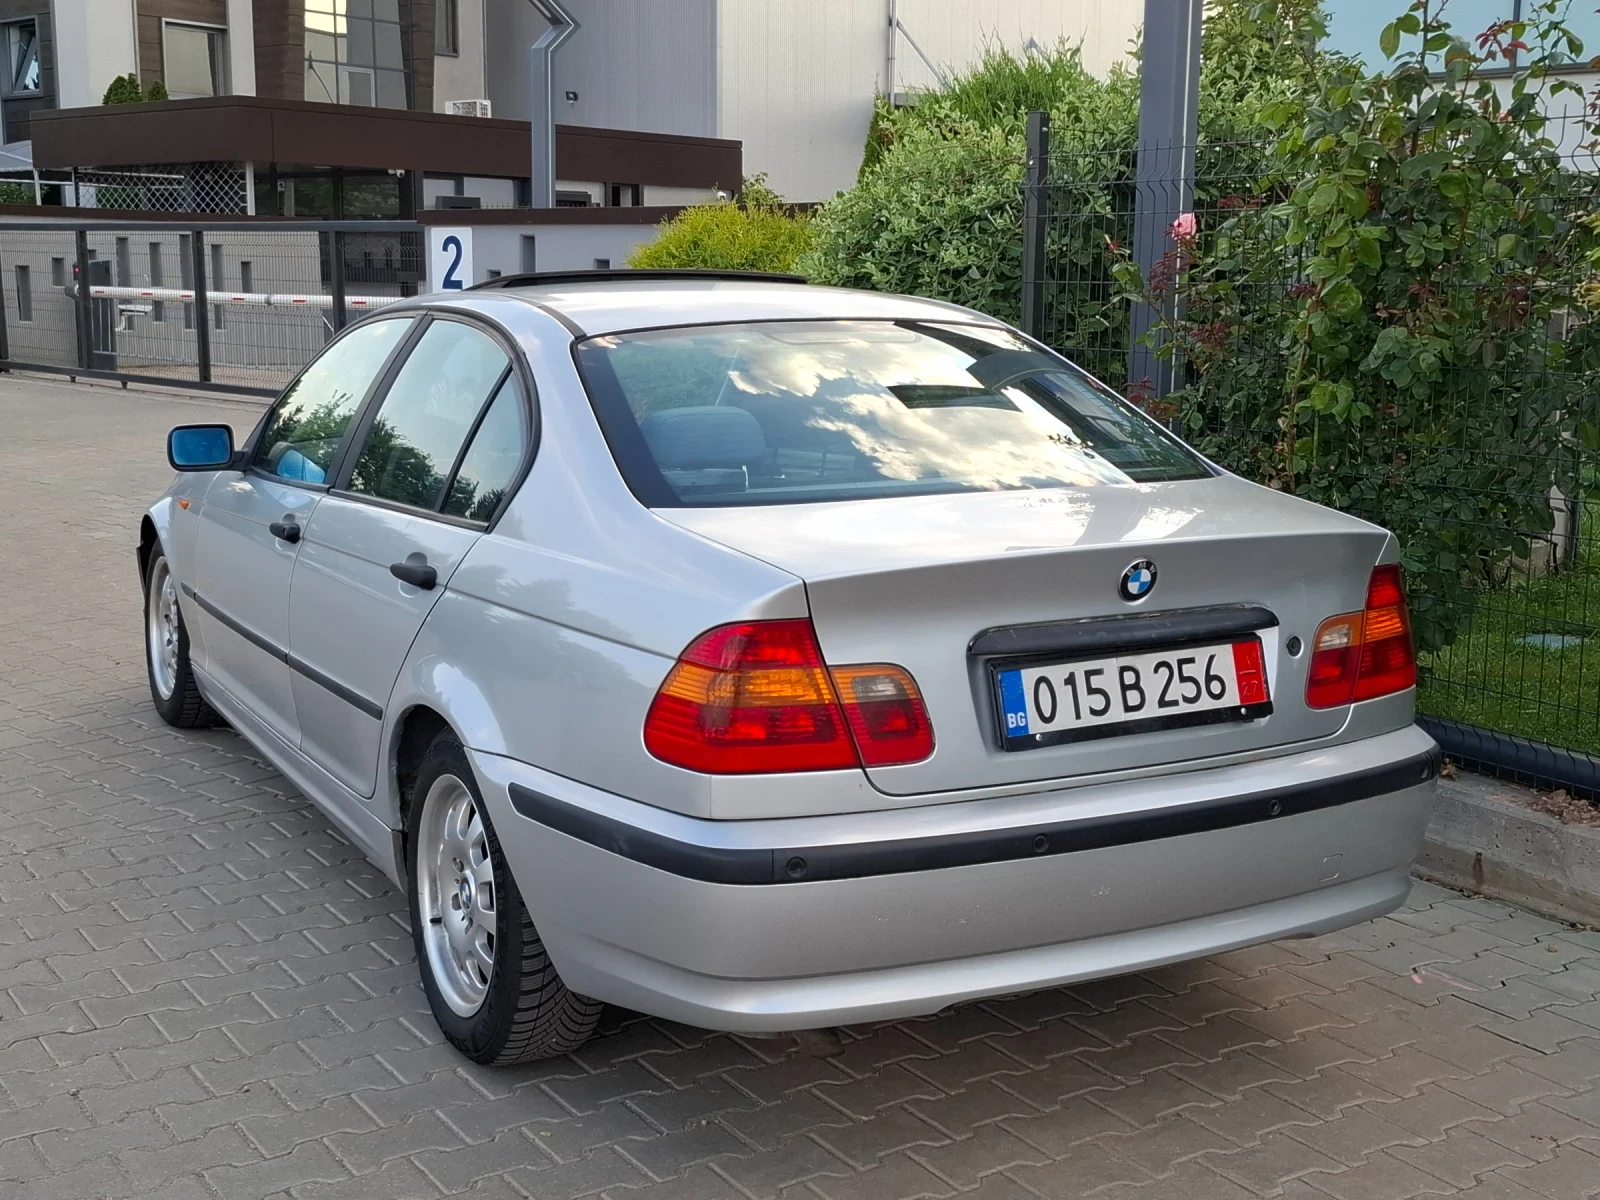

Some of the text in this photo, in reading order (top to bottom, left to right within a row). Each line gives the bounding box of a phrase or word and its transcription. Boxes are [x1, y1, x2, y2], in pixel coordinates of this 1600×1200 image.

[442, 235, 463, 290] 2
[1126, 561, 1157, 577] BMW
[1007, 712, 1027, 729] BG
